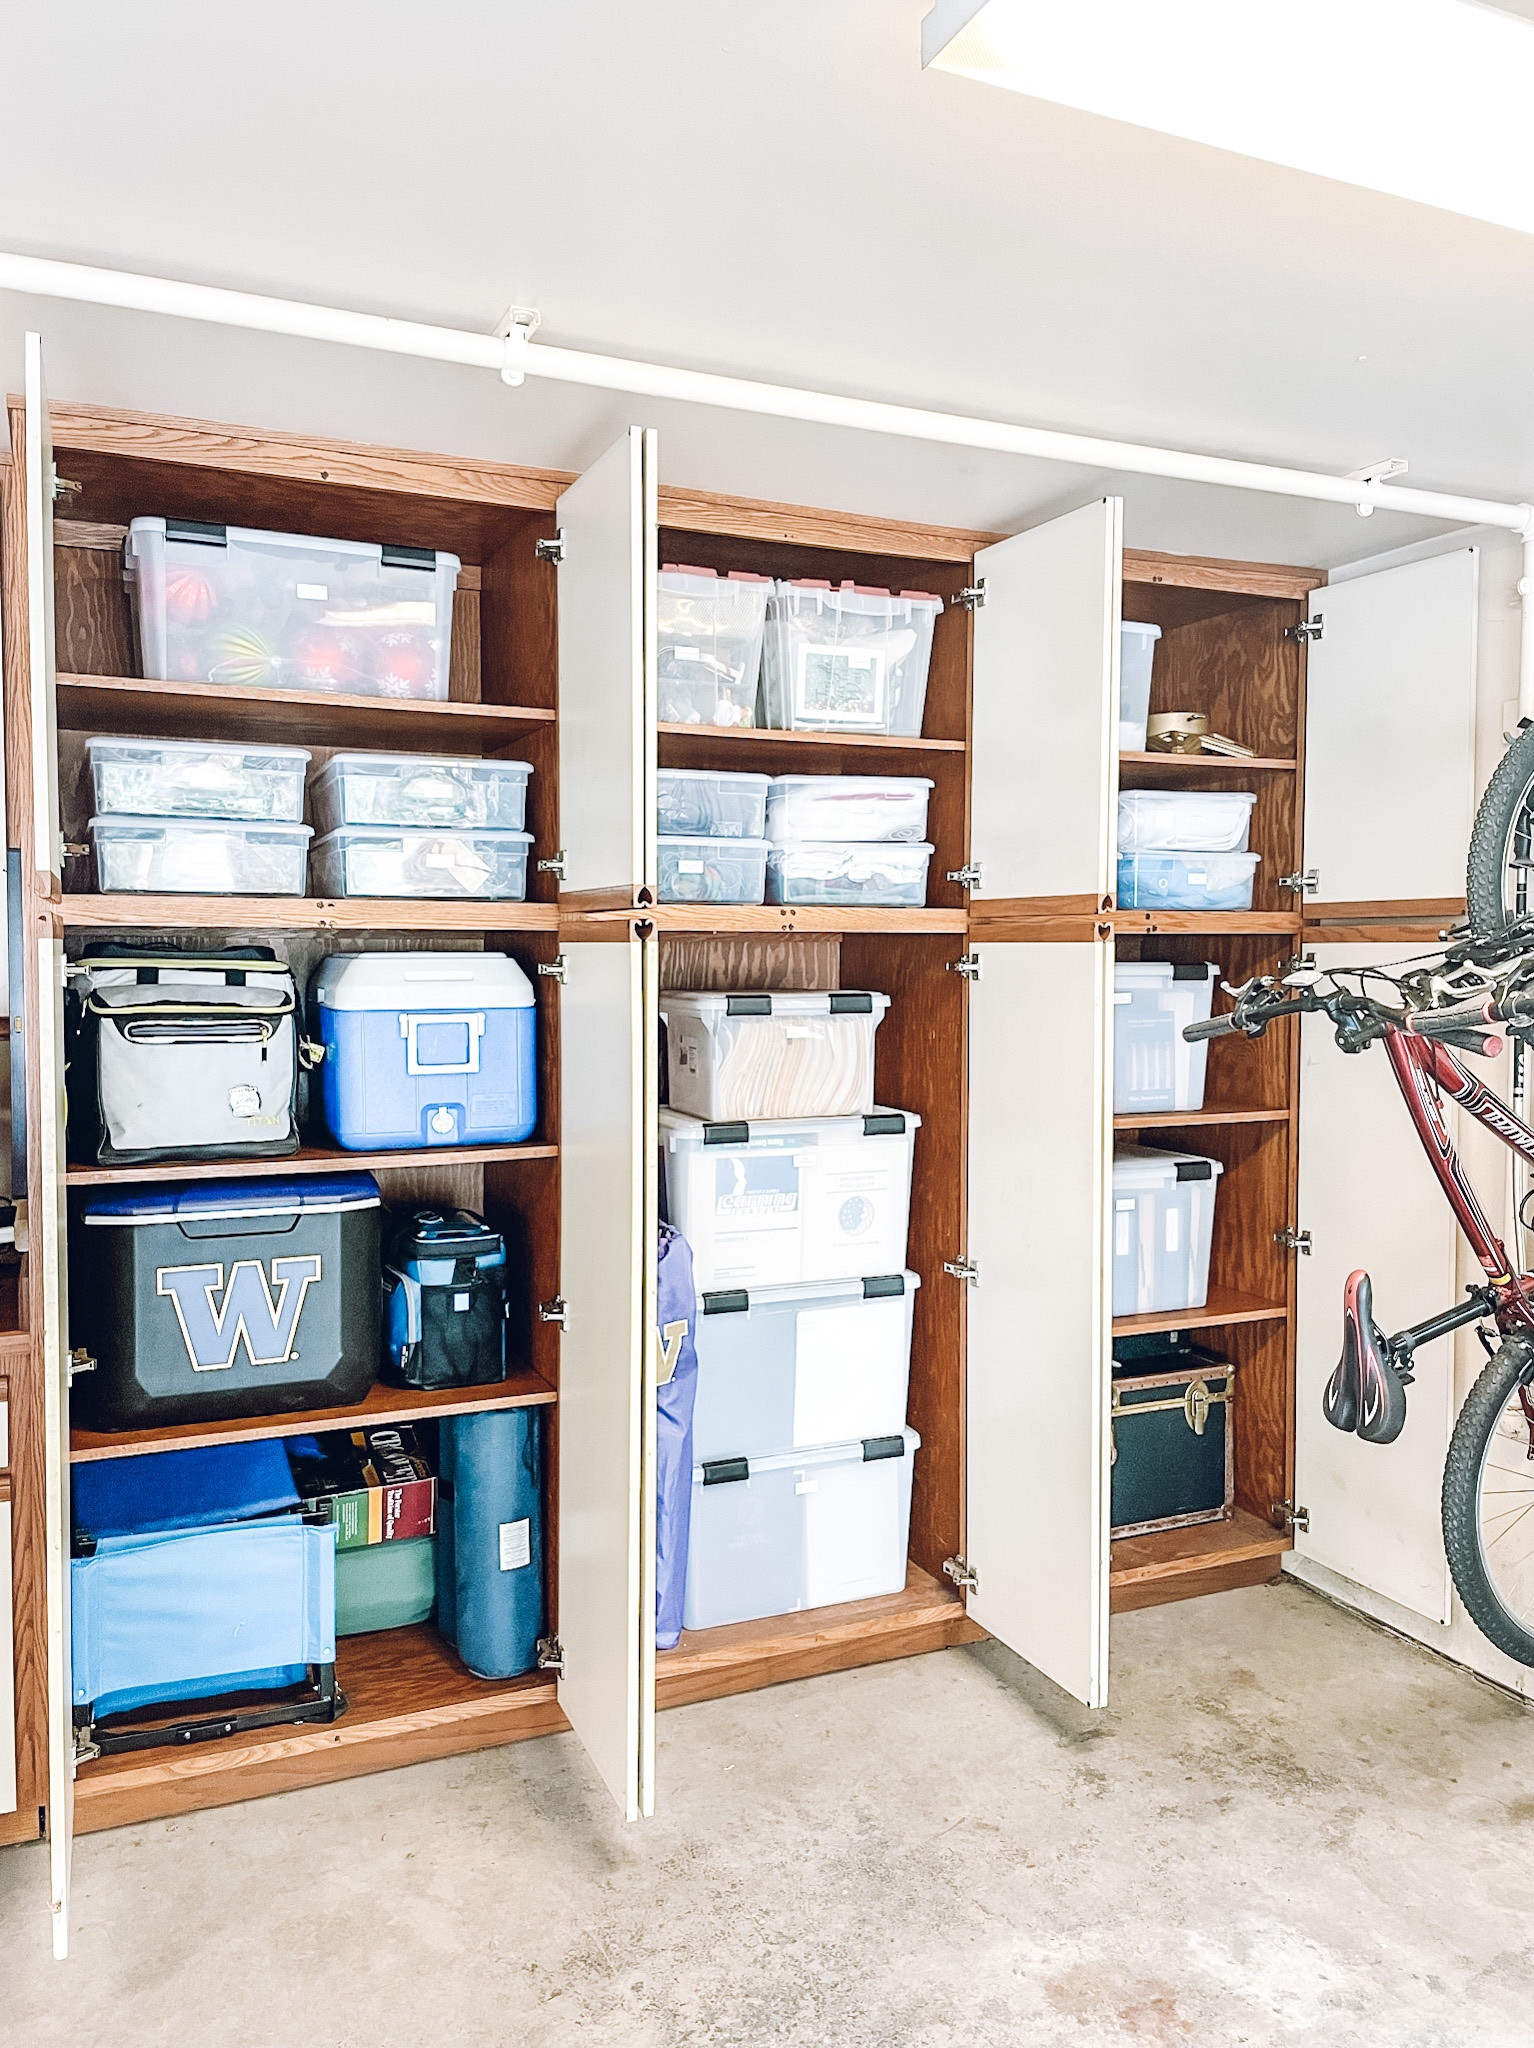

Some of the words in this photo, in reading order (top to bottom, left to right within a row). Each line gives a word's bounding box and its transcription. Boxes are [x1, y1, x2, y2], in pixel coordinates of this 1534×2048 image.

[245, 1115, 280, 1127] TITAN
[715, 1191, 799, 1216] Learning
[387, 1490, 395, 1514] Tradition
[394, 1488, 403, 1499] The
[385, 1519, 395, 1539] Quality
